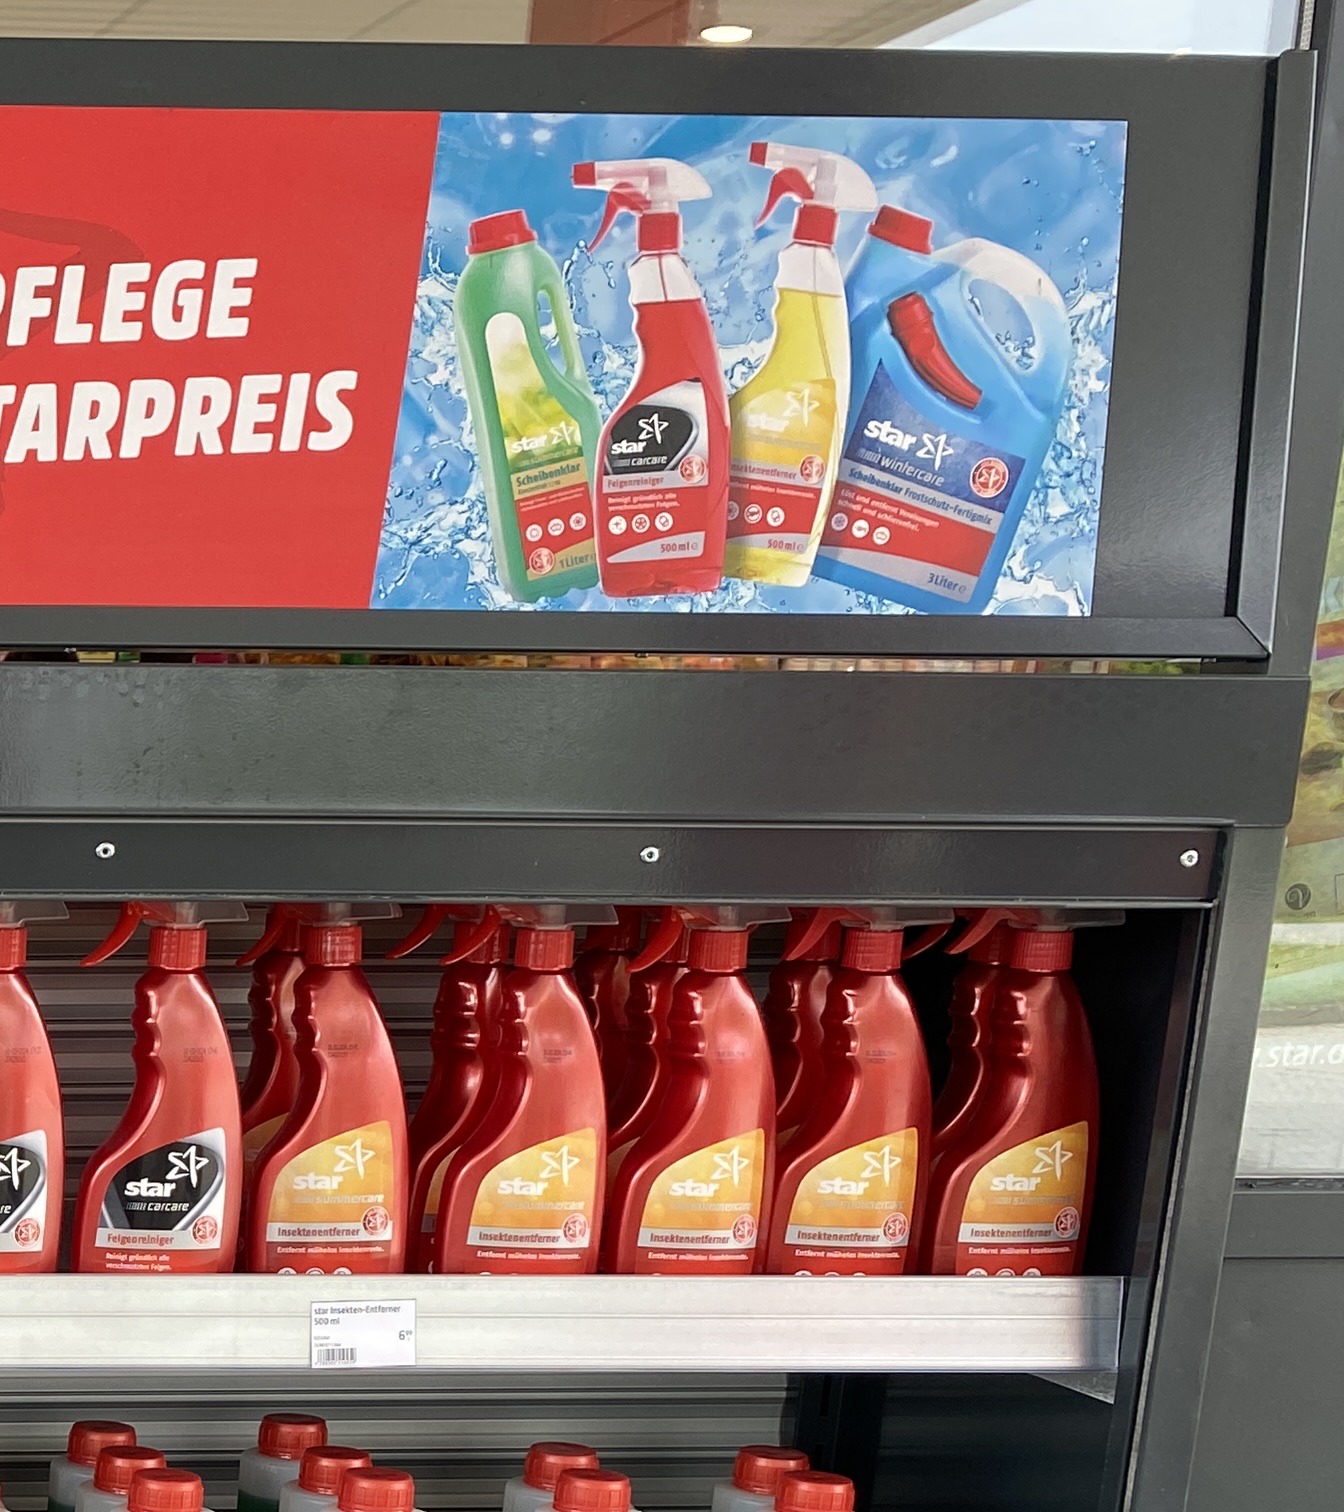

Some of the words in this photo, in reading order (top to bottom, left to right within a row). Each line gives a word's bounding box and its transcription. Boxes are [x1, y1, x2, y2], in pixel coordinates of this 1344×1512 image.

[512, 436, 546, 453] star
[863, 419, 916, 450] star
[611, 440, 646, 454] star
[632, 455, 667, 466] carcare
[880, 452, 944, 488] wintercare
[516, 462, 581, 488] Scheibenklar
[849, 468, 902, 495] Scheibenklar
[124, 1178, 176, 1198] star
[293, 1171, 343, 1191] star
[817, 1176, 870, 1197] star
[990, 1174, 1041, 1194] star
[278, 1226, 360, 1238] Insektenentferner
[797, 1230, 880, 1245] Insektenentferner
[969, 1227, 1053, 1239] Insektenentferner
[330, 1305, 401, 1314] Insekten-Entferner
